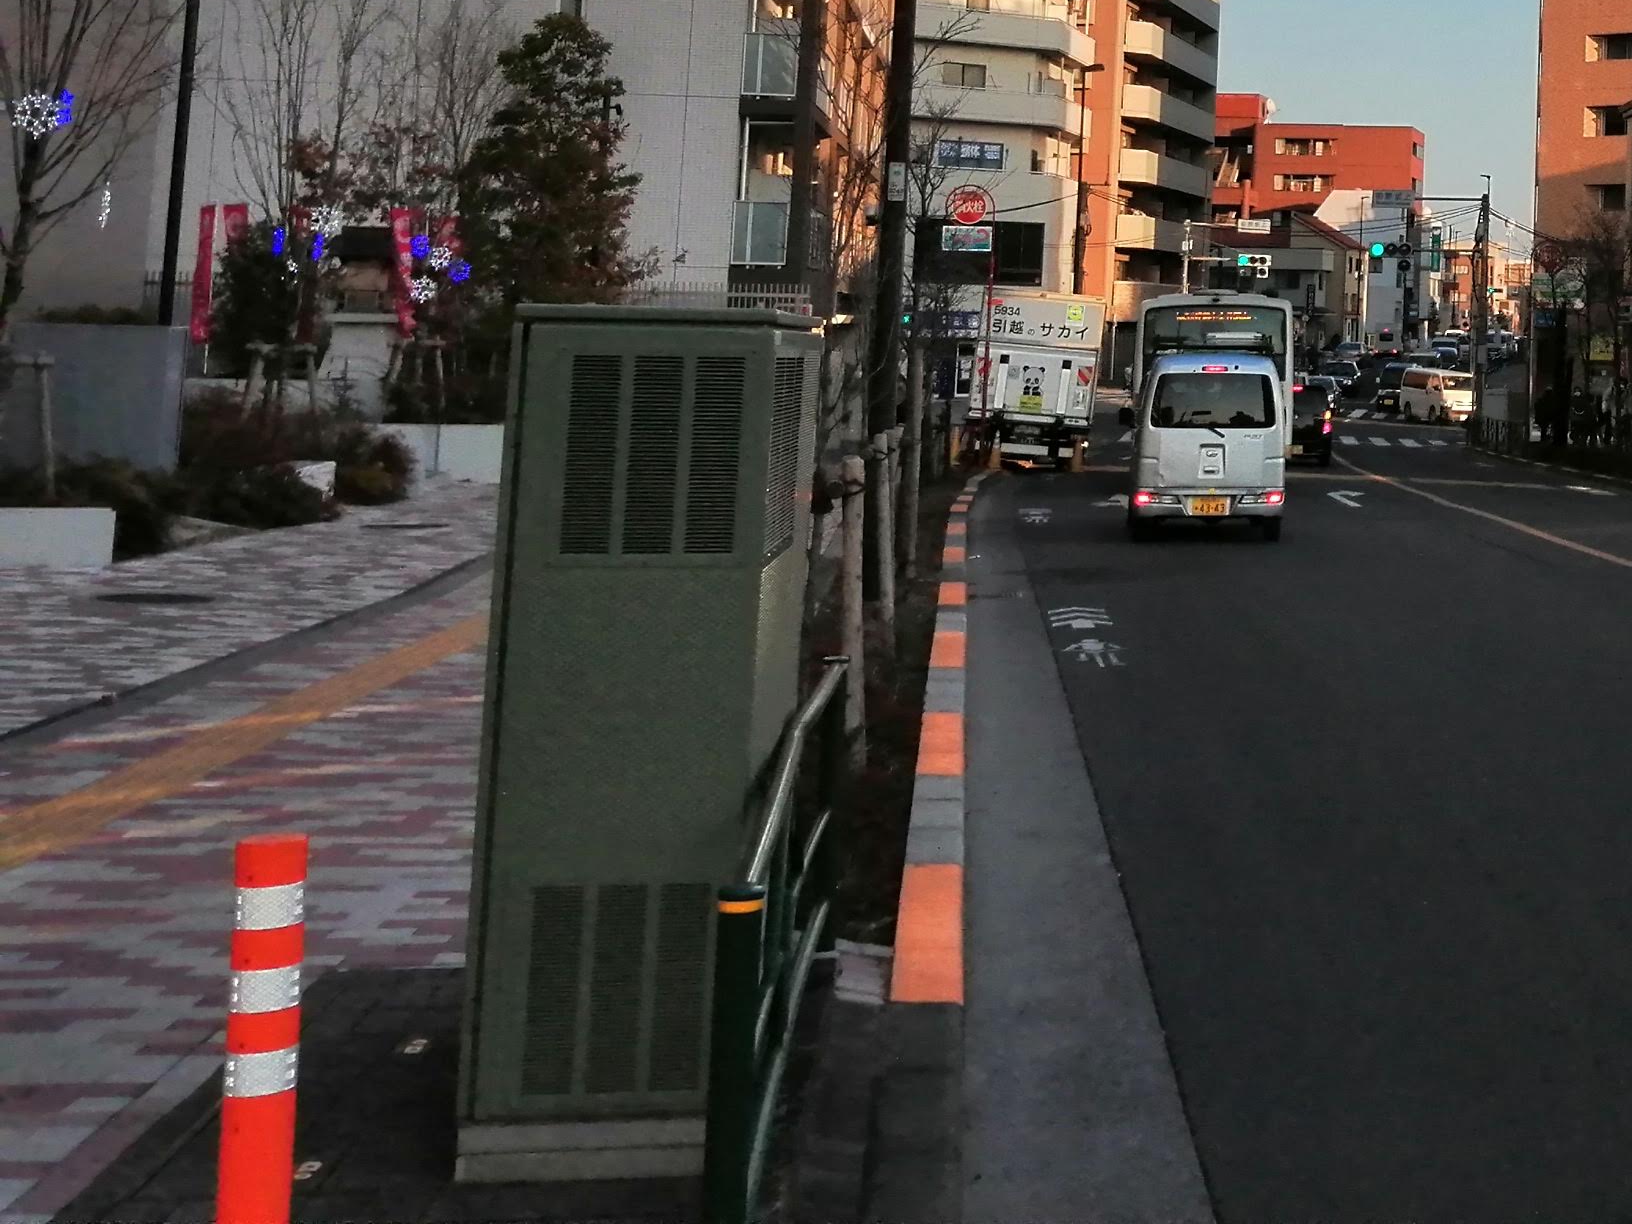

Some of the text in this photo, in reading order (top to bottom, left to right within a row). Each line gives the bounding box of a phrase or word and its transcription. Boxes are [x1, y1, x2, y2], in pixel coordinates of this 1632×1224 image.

[994, 305, 1021, 316] 5934
[992, 318, 1089, 340] 引越のサカイ
